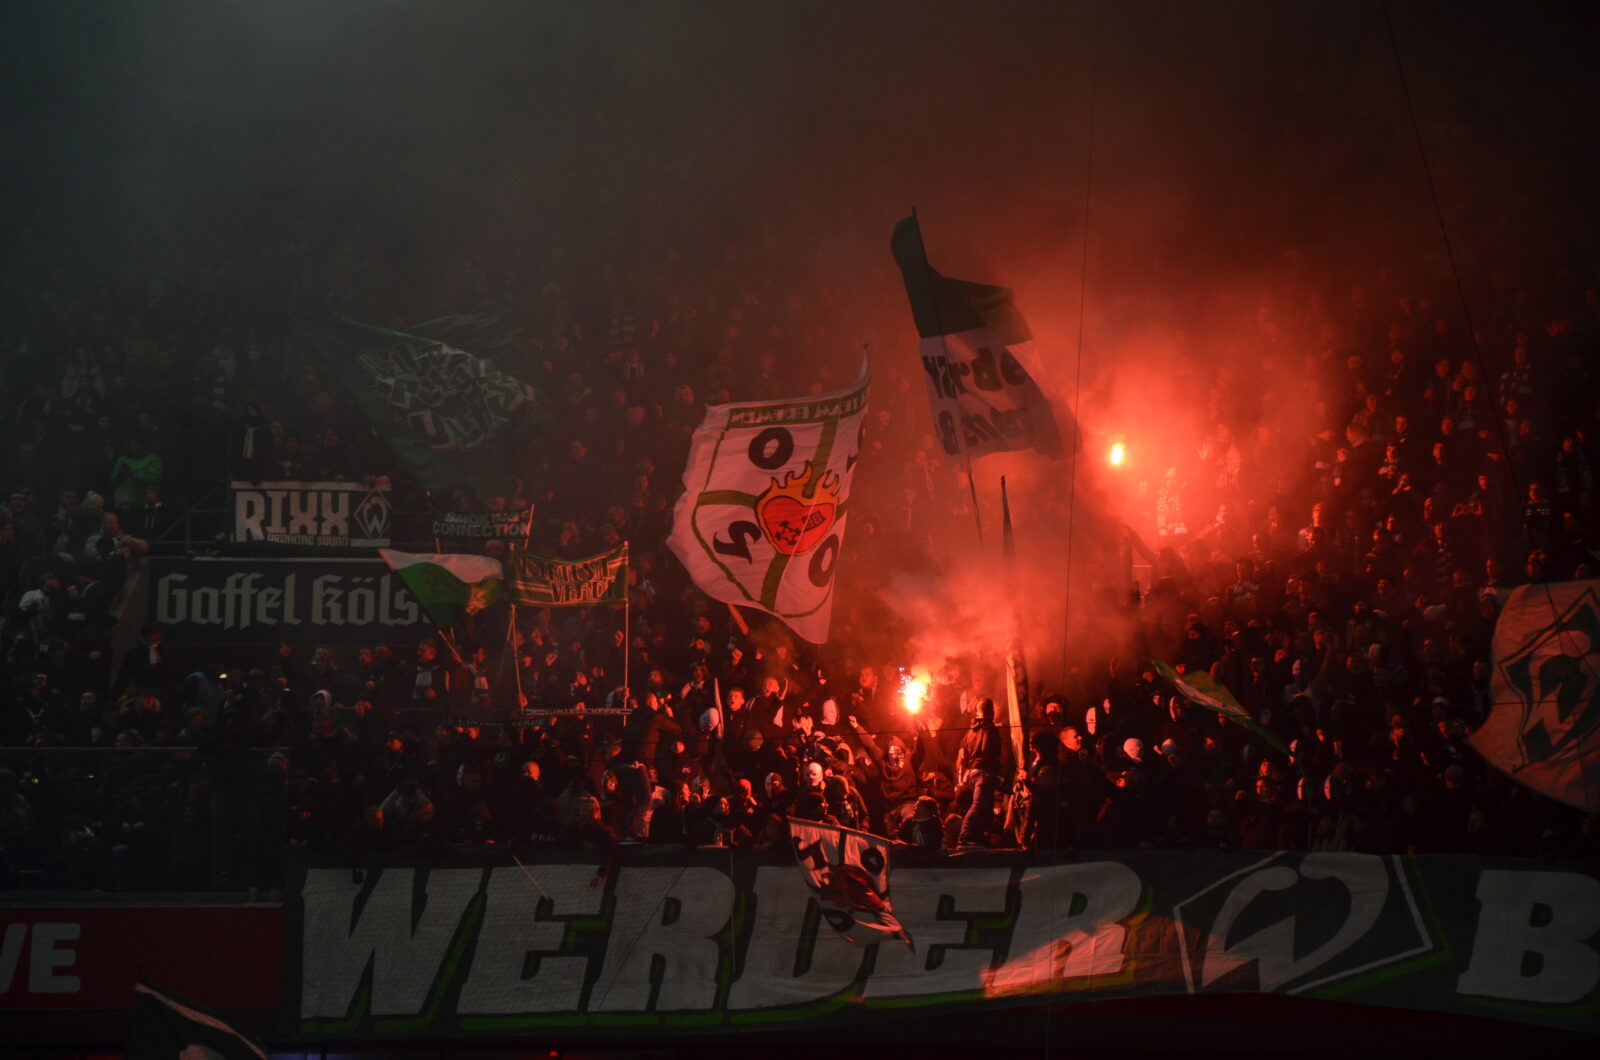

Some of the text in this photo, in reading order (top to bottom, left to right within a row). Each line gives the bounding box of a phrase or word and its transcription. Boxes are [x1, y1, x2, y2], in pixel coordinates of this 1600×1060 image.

[235, 490, 349, 543] RIXX
[266, 533, 349, 546] DRINKING SQUAD
[432, 521, 532, 537] CONNECTION
[157, 572, 432, 630] Gaffel Köls
[300, 860, 1142, 1019] WERDER
